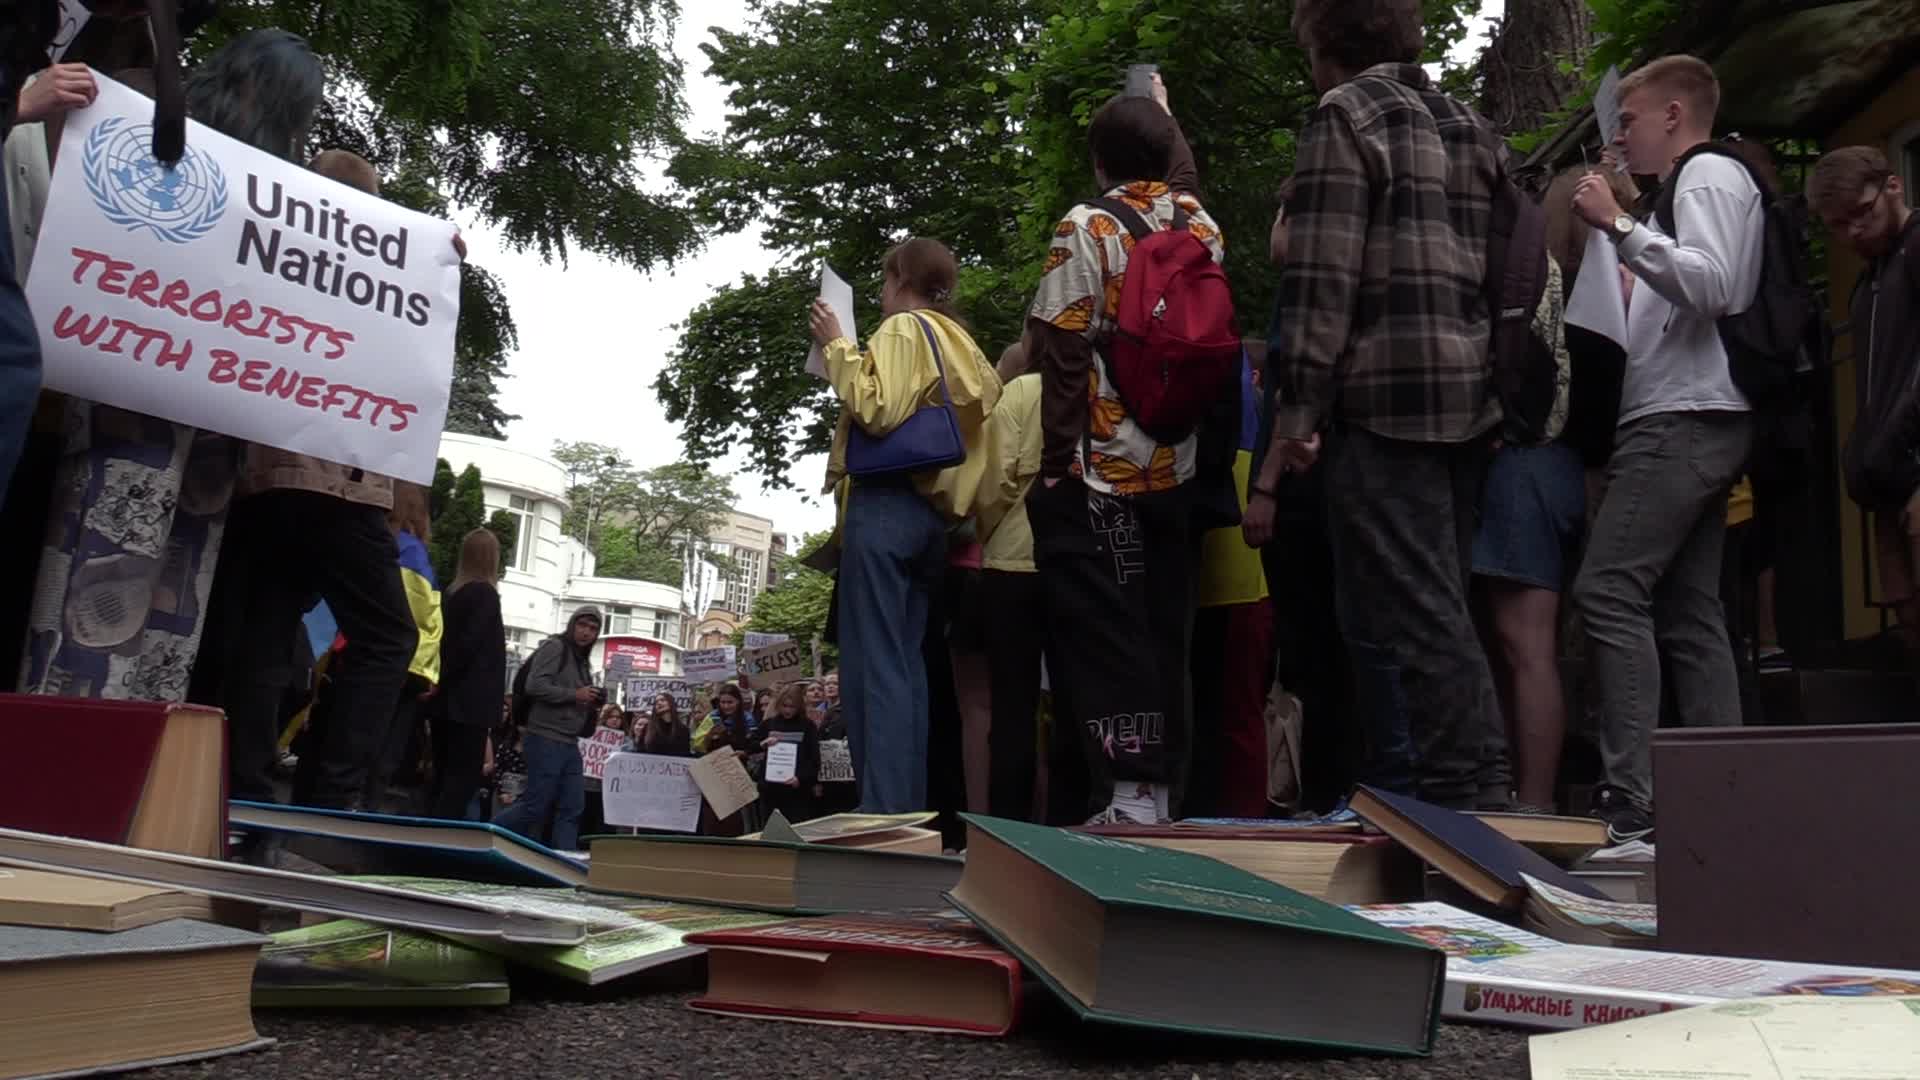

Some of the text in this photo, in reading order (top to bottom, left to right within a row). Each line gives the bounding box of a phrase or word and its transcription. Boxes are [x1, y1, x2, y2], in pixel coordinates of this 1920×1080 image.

[236, 219, 431, 327] Nations
[248, 173, 408, 270] United
[71, 247, 354, 360] TERRORISTS
[53, 305, 418, 432] WITH BENEFITS
[1464, 983, 1574, 1017] БУМАЖНЫЕ
